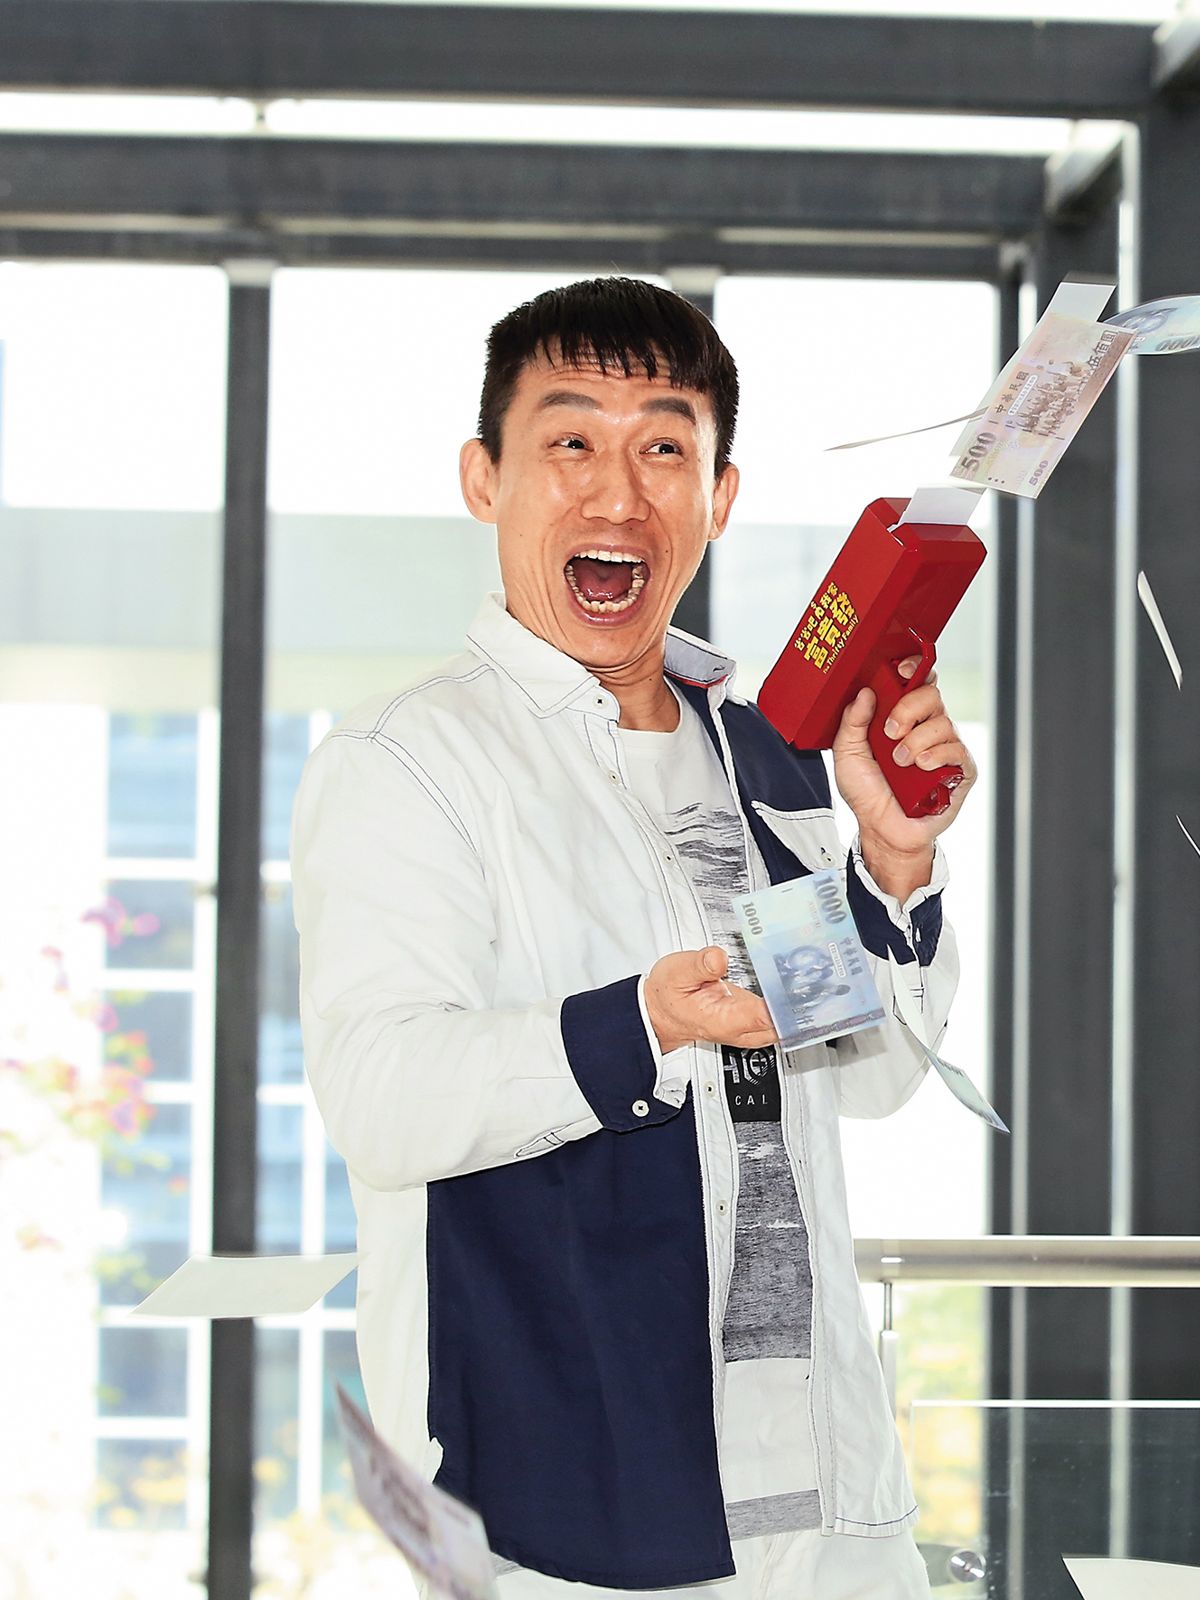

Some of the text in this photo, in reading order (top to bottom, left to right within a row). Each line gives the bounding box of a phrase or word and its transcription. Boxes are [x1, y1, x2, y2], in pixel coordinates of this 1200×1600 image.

[961, 432, 996, 475] 500
[1029, 460, 1049, 486] 500
[804, 592, 855, 669] 富貴發
[741, 902, 763, 936] 1000
[815, 876, 847, 925] 1000
